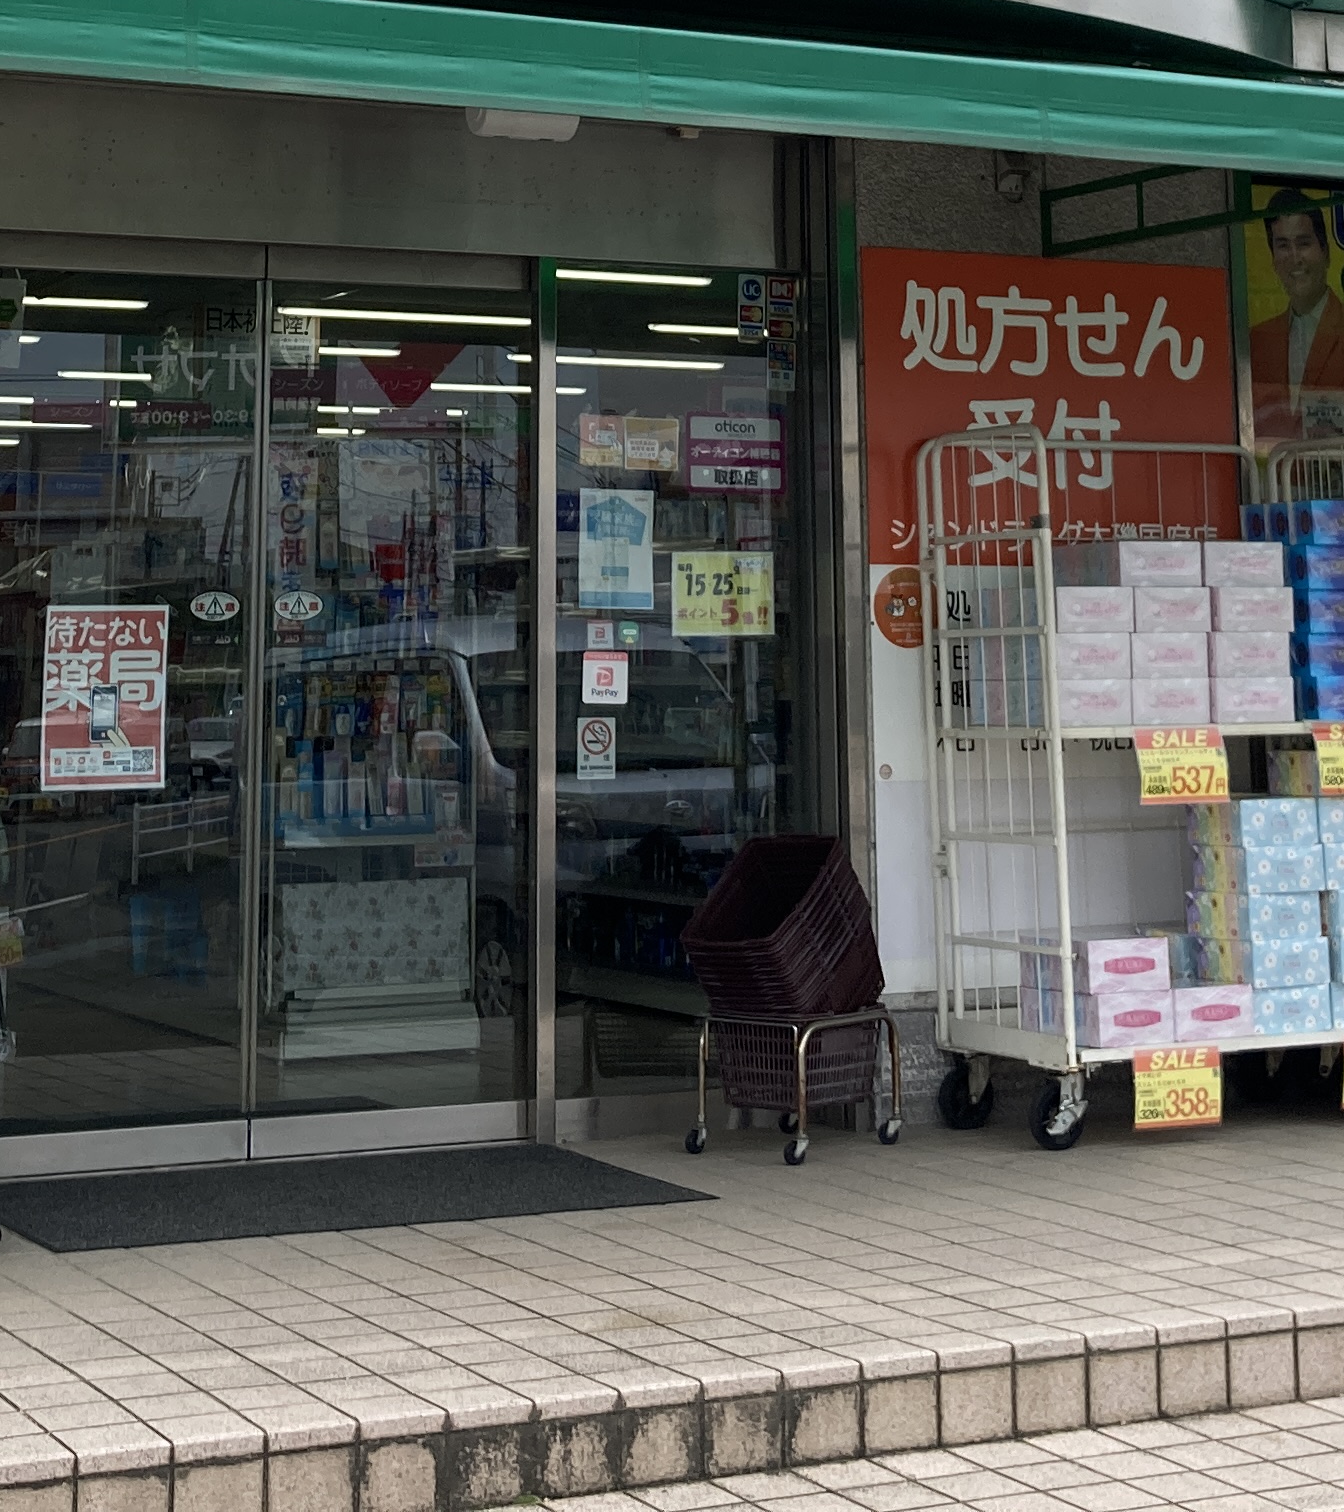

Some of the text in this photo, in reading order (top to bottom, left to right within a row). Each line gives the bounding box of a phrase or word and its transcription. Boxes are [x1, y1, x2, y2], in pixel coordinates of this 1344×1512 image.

[744, 282, 761, 297] UC
[900, 280, 1204, 380] 処方せん
[714, 421, 756, 434] oticon
[967, 397, 1121, 490] 受付
[47, 615, 165, 648] 待たない
[44, 648, 165, 712] 薬局
[591, 688, 619, 698] PayPay
[1151, 730, 1208, 748] SALE
[1150, 1048, 1209, 1070] SALE
